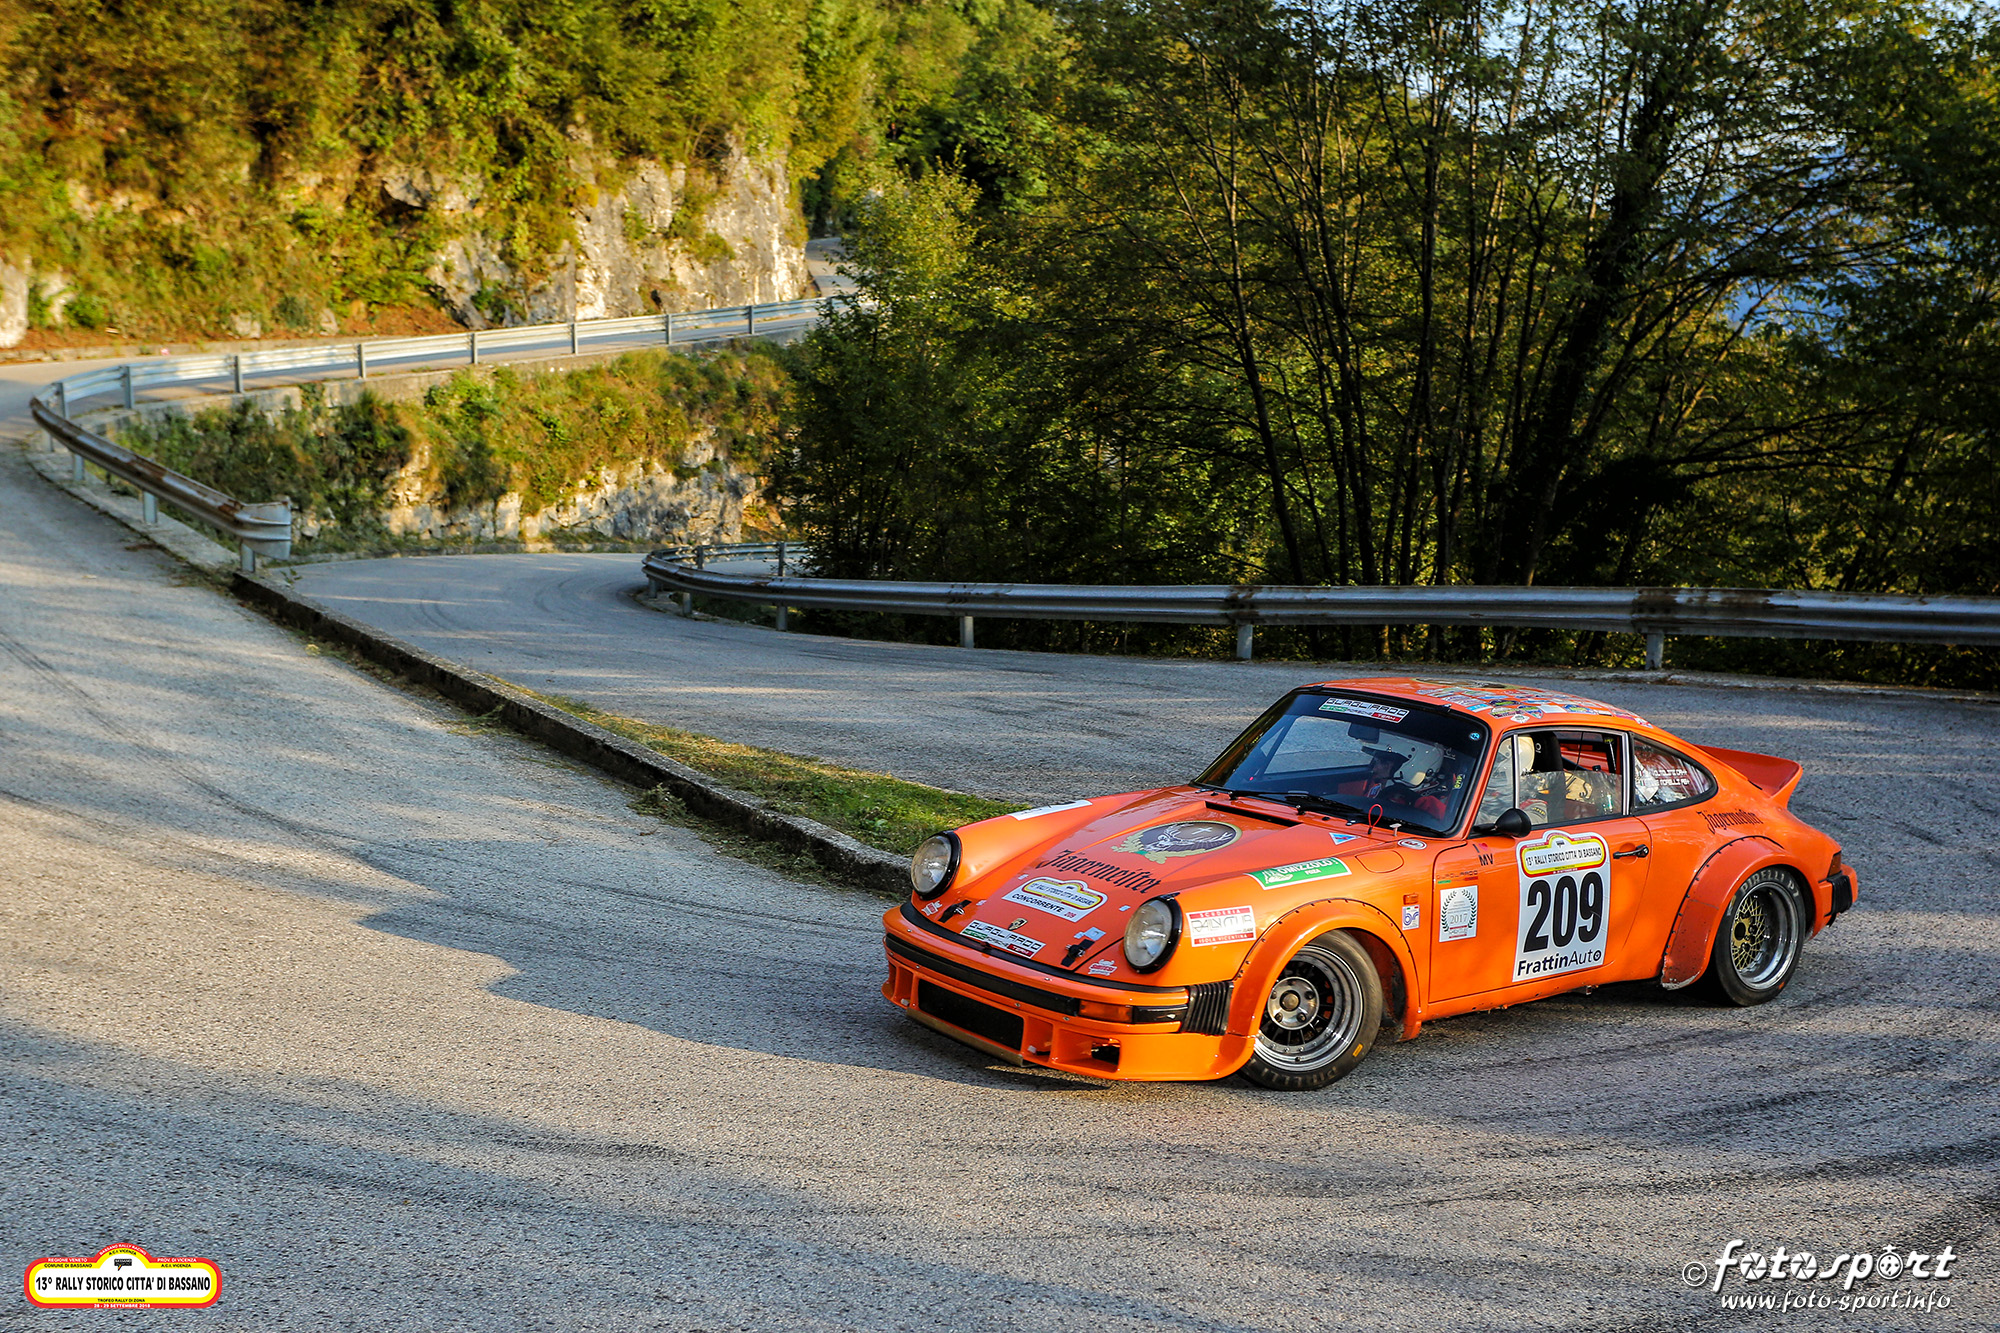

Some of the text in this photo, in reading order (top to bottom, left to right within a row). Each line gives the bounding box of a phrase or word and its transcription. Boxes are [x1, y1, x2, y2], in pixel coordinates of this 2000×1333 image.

[1478, 853, 1494, 866] MV
[1535, 854, 1547, 865] RALLY
[1547, 851, 1565, 863] STORICO
[1583, 847, 1602, 858] BASSANO
[1740, 869, 1785, 894] PIRELLI
[1011, 893, 1065, 913] CONCORRENTE
[1523, 871, 1604, 953] 209
[1449, 913, 1468, 925] 2017
[1517, 949, 1602, 976] FrattinAuto
